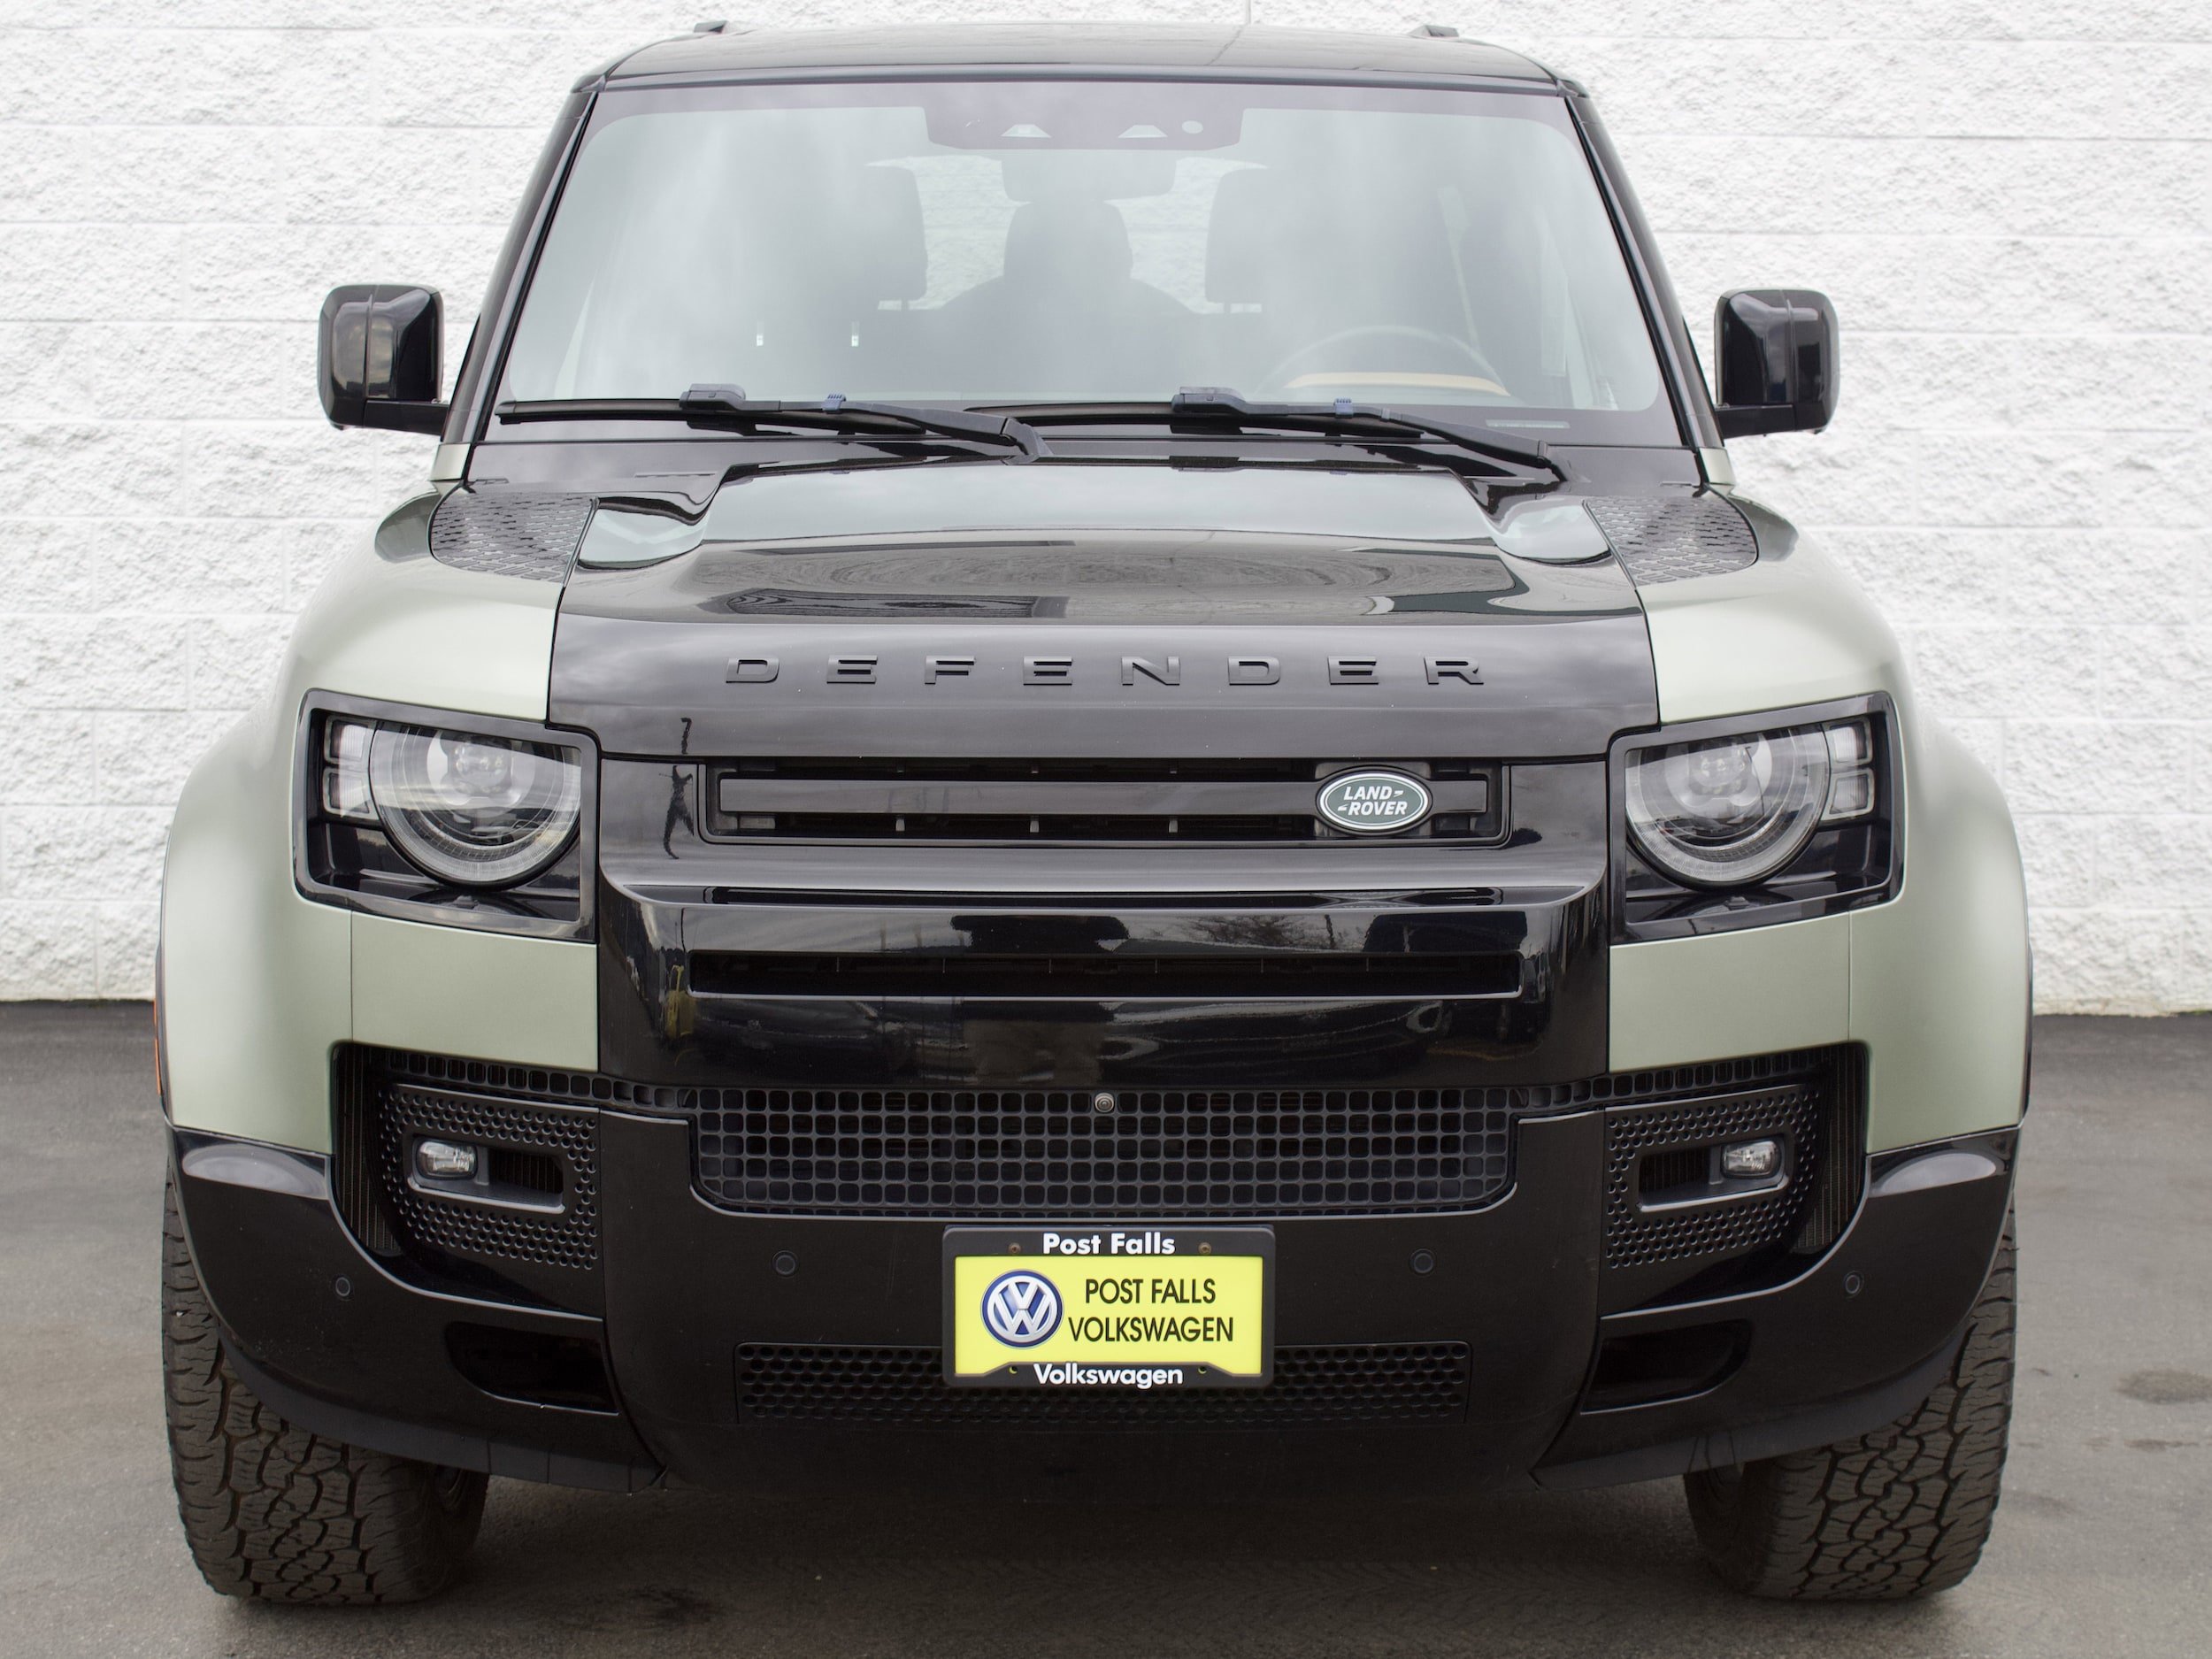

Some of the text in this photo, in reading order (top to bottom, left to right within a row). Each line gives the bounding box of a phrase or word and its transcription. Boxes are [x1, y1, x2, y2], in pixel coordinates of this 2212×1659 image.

[726, 655, 1485, 687] DEFENDER
[1343, 786, 1393, 801] LAND
[1348, 801, 1408, 816] ROVER
[1042, 1232, 1176, 1255] Post Falls
[1085, 1278, 1216, 1304] POST FALLS
[1068, 1317, 1233, 1342] VOLKSWAGEN
[1033, 1363, 1184, 1389] Volkswagen
